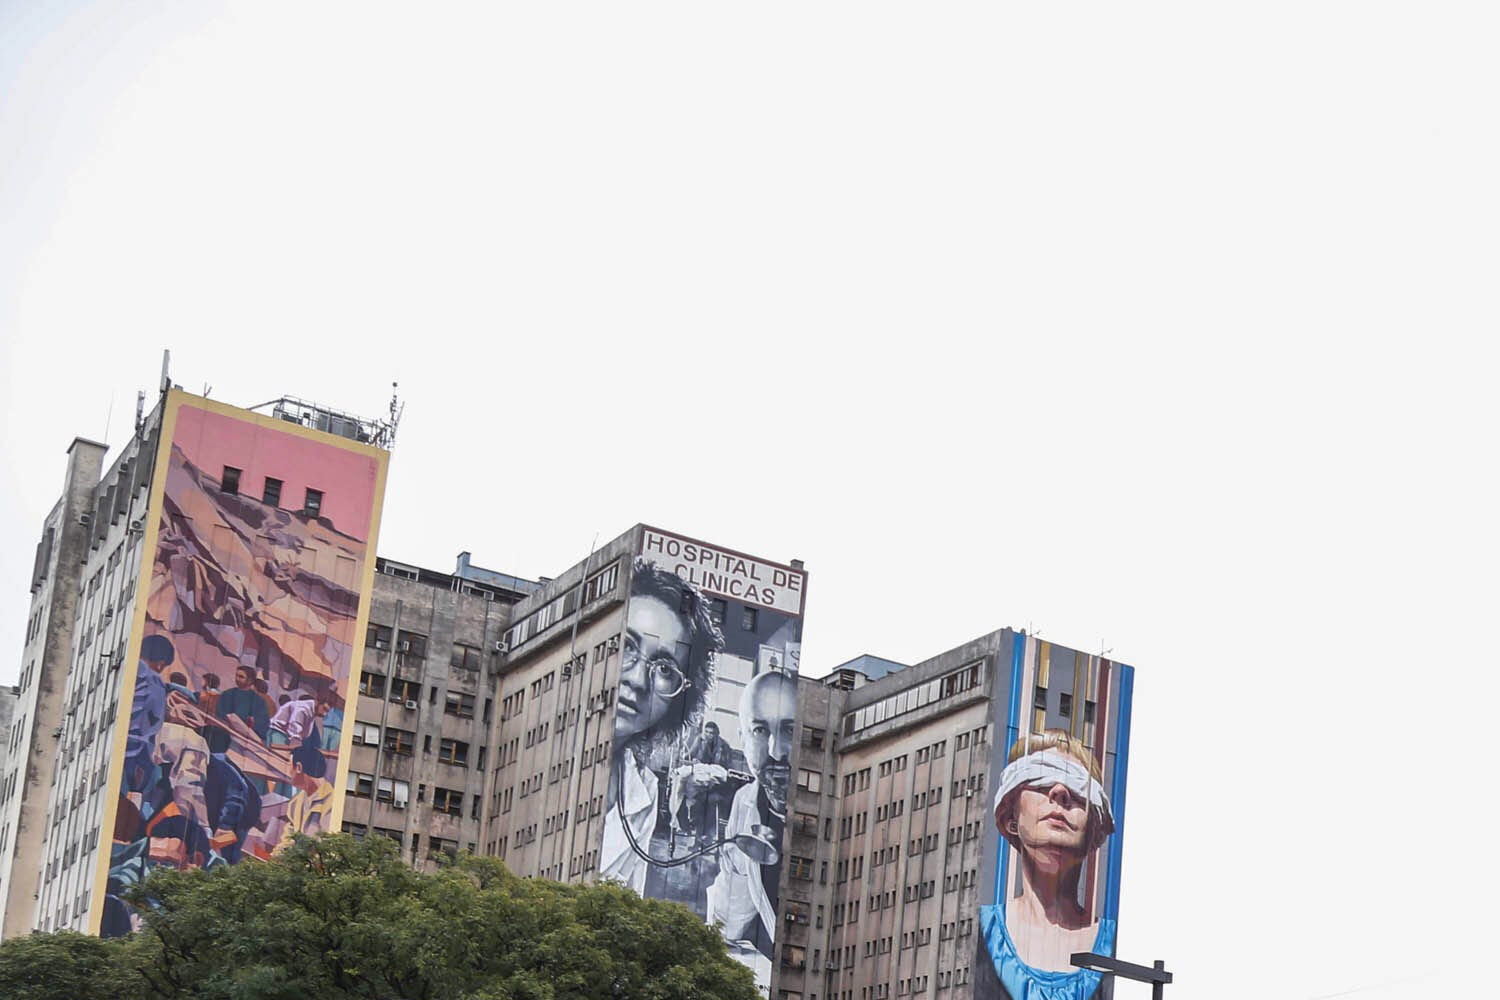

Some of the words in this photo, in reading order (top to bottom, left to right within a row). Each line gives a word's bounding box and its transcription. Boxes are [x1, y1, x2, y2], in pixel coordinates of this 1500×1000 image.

[647, 533, 762, 582] HOSPITAL
[772, 570, 801, 592] DE
[674, 563, 776, 606] CLINICAS
